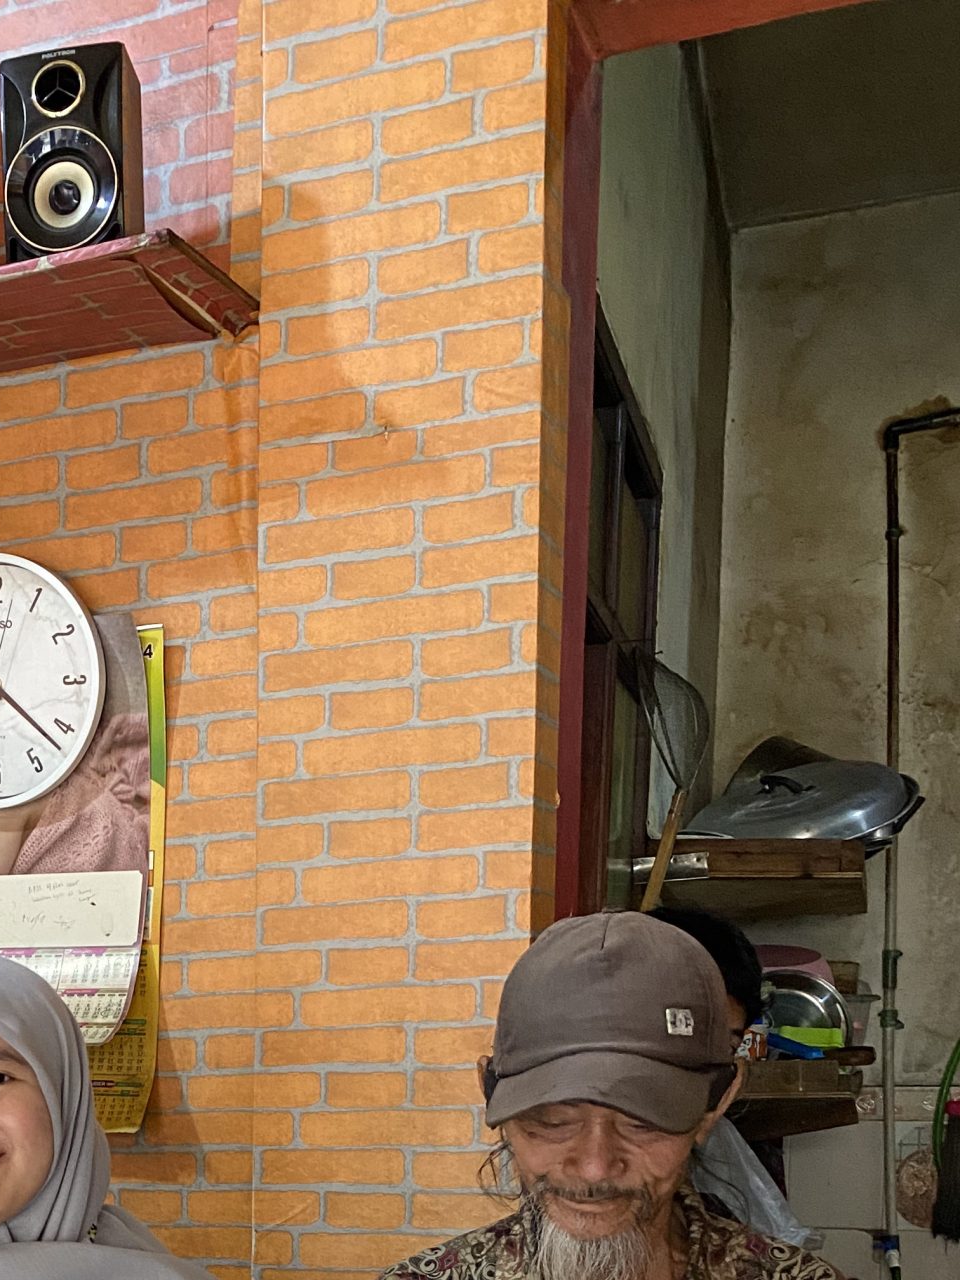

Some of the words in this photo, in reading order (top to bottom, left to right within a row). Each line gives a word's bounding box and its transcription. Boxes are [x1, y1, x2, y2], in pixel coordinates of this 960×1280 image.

[29, 588, 43, 612] 1
[52, 623, 75, 645] 2
[62, 674, 87, 686] 3
[53, 717, 75, 735] 4
[26, 747, 43, 773] 5
